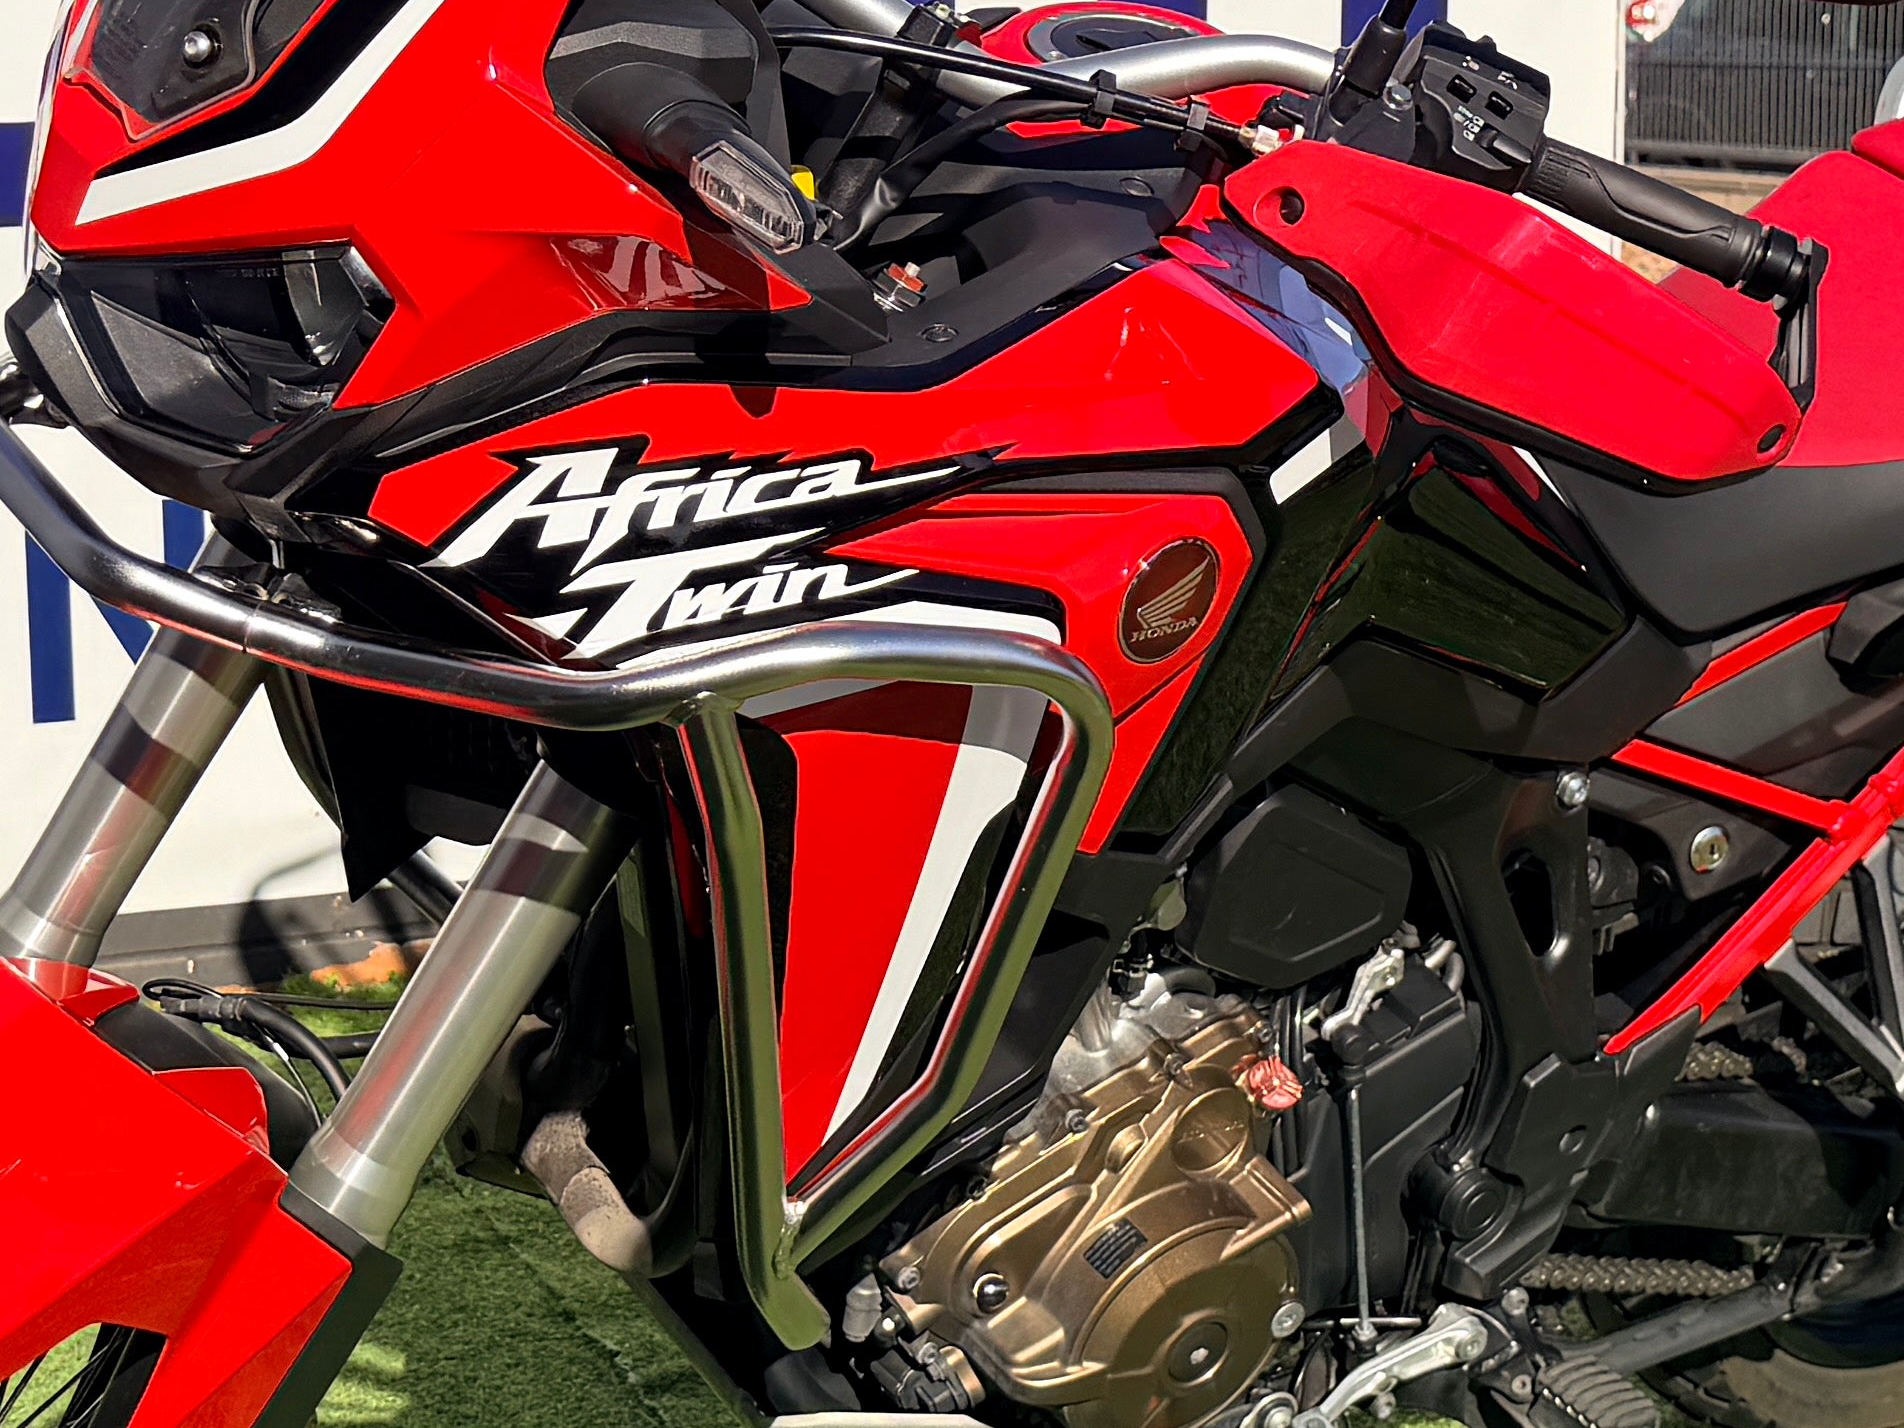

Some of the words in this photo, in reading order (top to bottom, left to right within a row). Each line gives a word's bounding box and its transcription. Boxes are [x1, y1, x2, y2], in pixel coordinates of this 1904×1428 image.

[418, 447, 962, 575] Africa
[560, 527, 920, 660] Twin
[1128, 616, 1199, 643] HONDA
